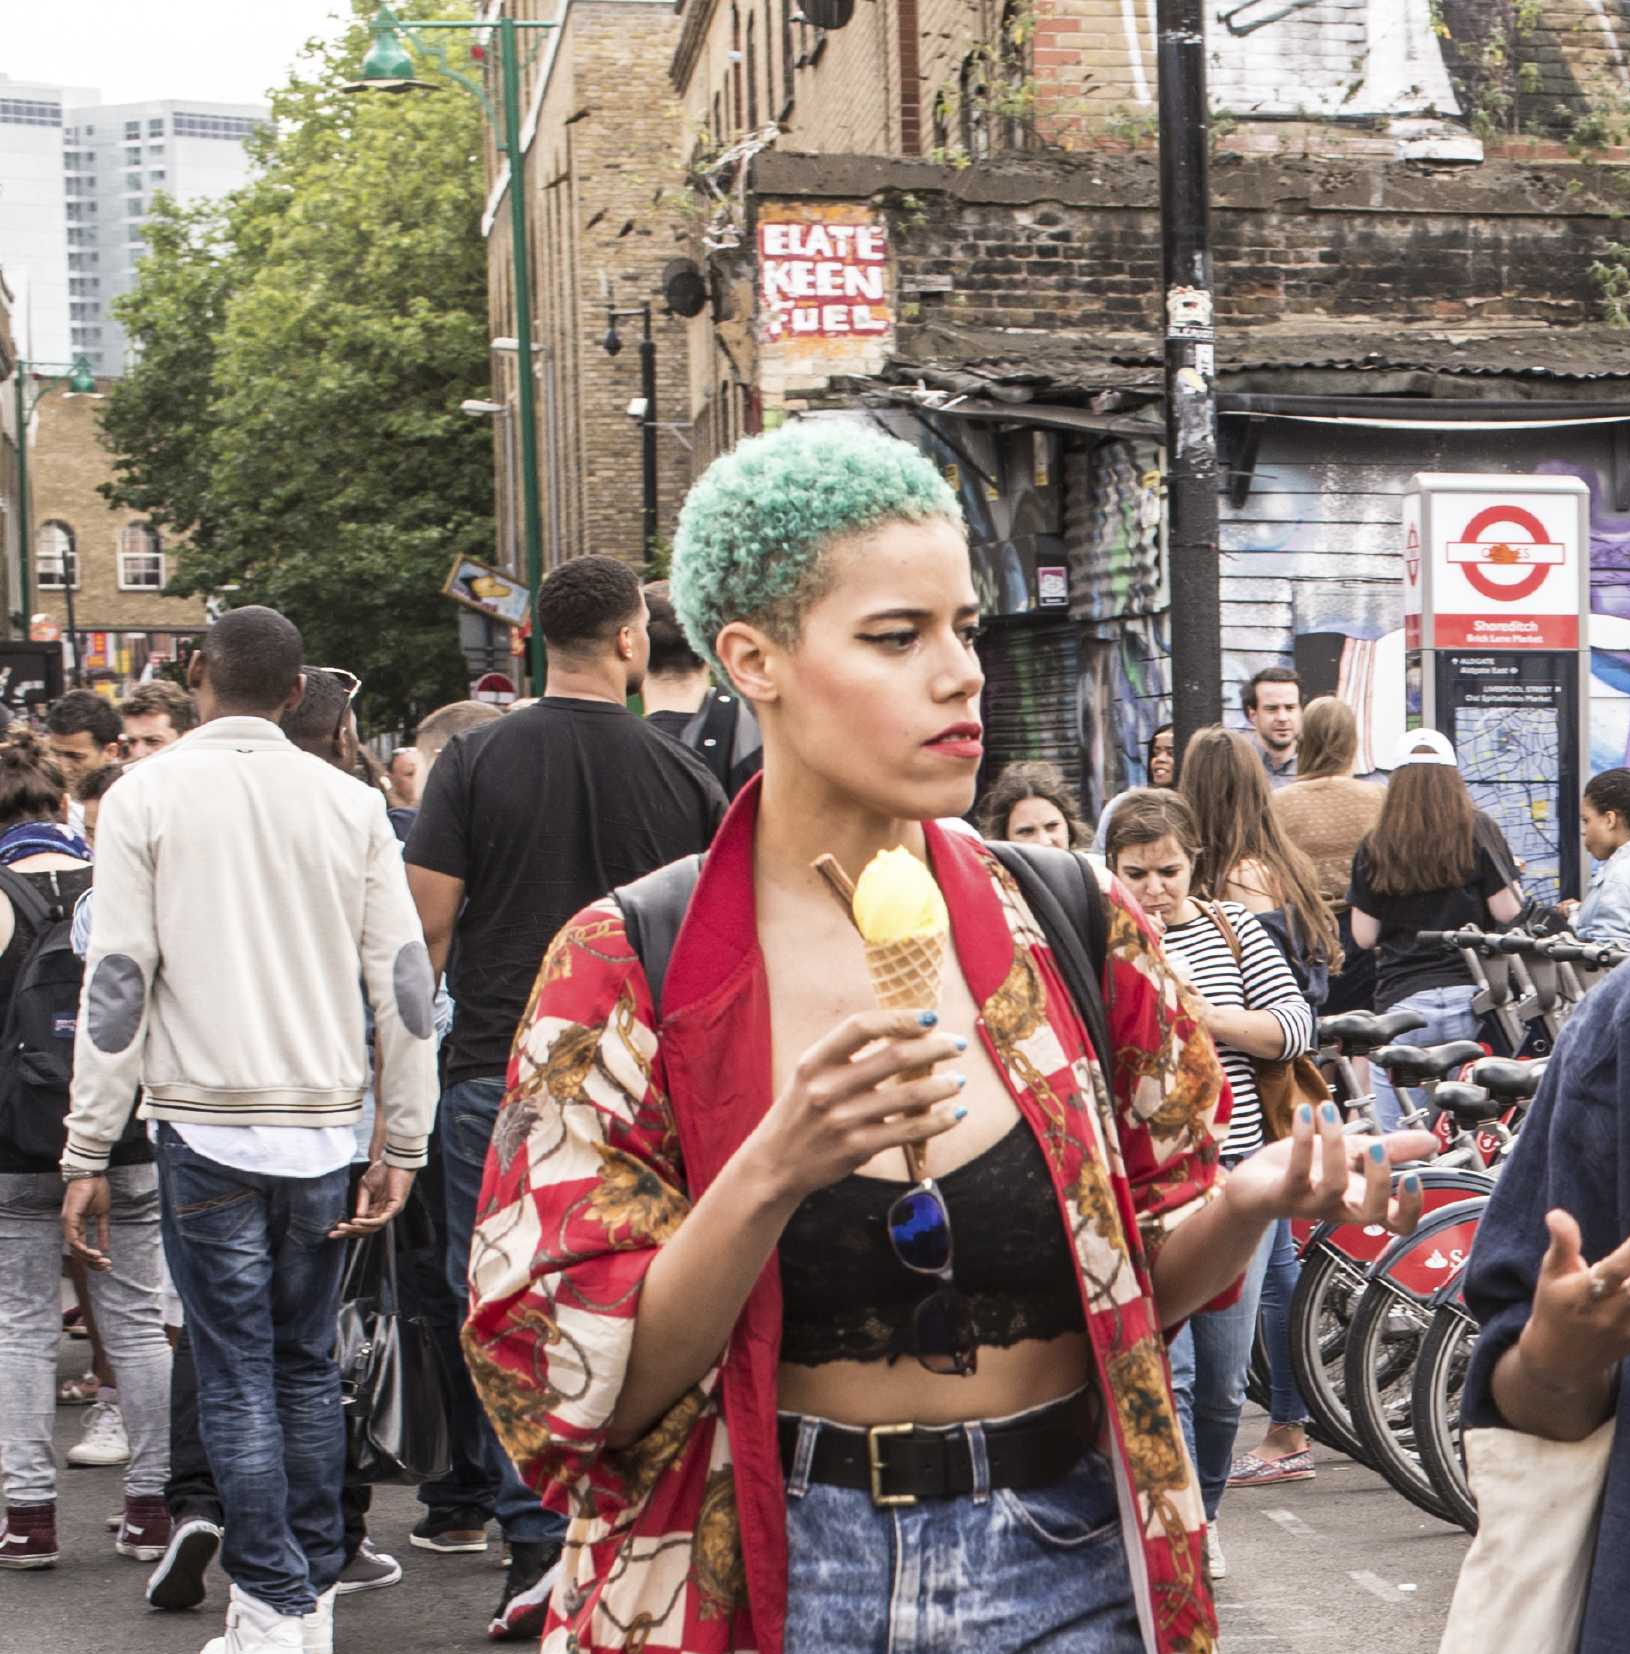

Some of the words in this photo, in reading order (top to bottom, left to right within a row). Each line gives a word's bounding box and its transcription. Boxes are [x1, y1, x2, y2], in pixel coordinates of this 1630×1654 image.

[763, 223, 885, 260] ELATE
[763, 260, 884, 299] KEEN
[769, 300, 889, 334] FUEL
[1465, 633, 1489, 643] Brick
[1489, 634, 1512, 643] Lane
[1512, 634, 1544, 644] Market
[1473, 619, 1539, 632] Shoreditch
